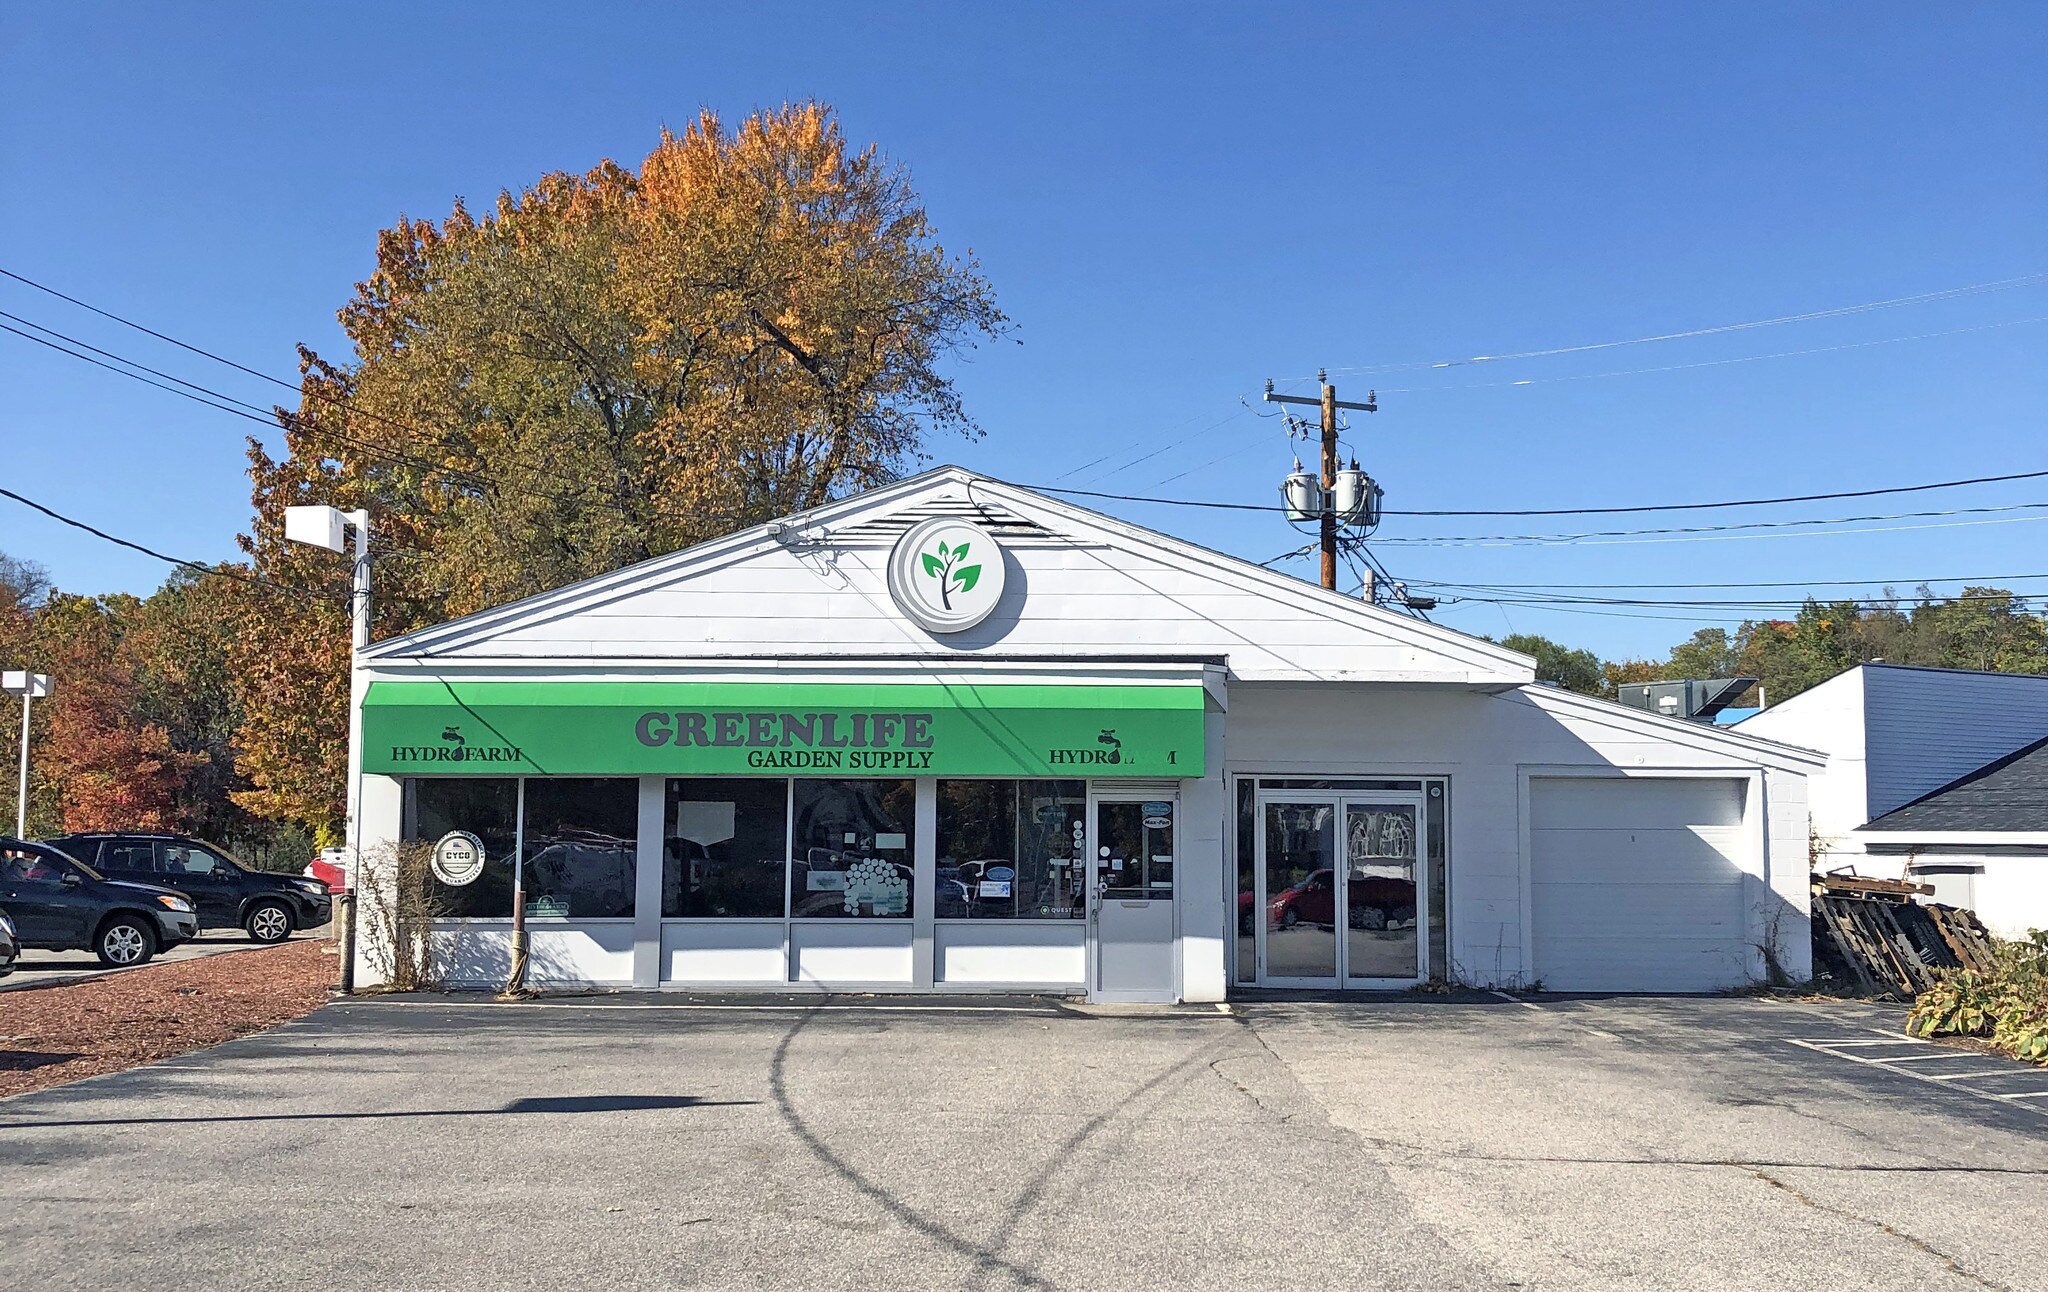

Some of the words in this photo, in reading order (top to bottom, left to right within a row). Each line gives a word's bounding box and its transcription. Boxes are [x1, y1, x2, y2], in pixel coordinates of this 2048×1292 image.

[635, 711, 935, 748] GREENLIFE
[747, 750, 843, 768] GARDEN
[849, 750, 934, 769] SUPPLY
